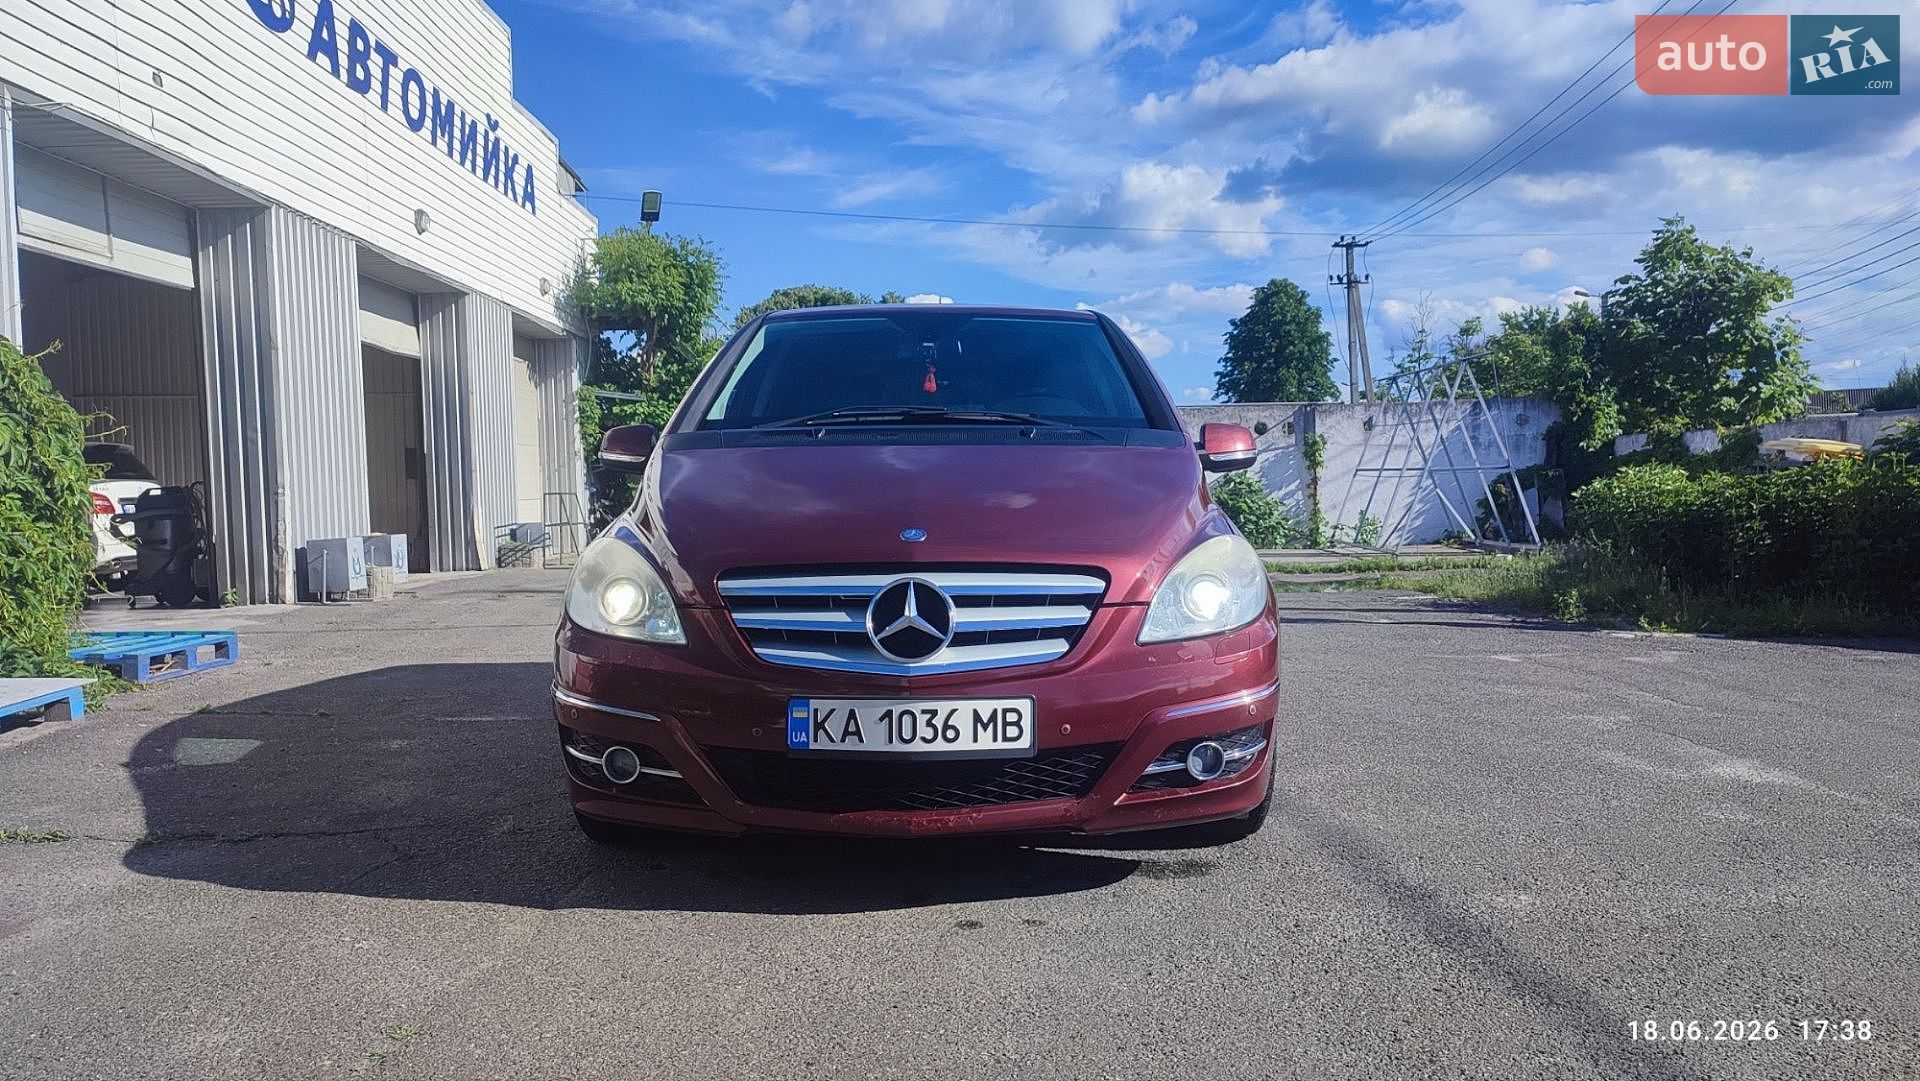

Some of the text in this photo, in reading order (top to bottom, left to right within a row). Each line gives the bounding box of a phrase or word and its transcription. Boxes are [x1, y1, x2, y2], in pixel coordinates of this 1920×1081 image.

[306, 0, 536, 216] АВТОМИЙКА
[793, 732, 807, 742] UA
[813, 708, 1024, 744] KA 1036 MB
